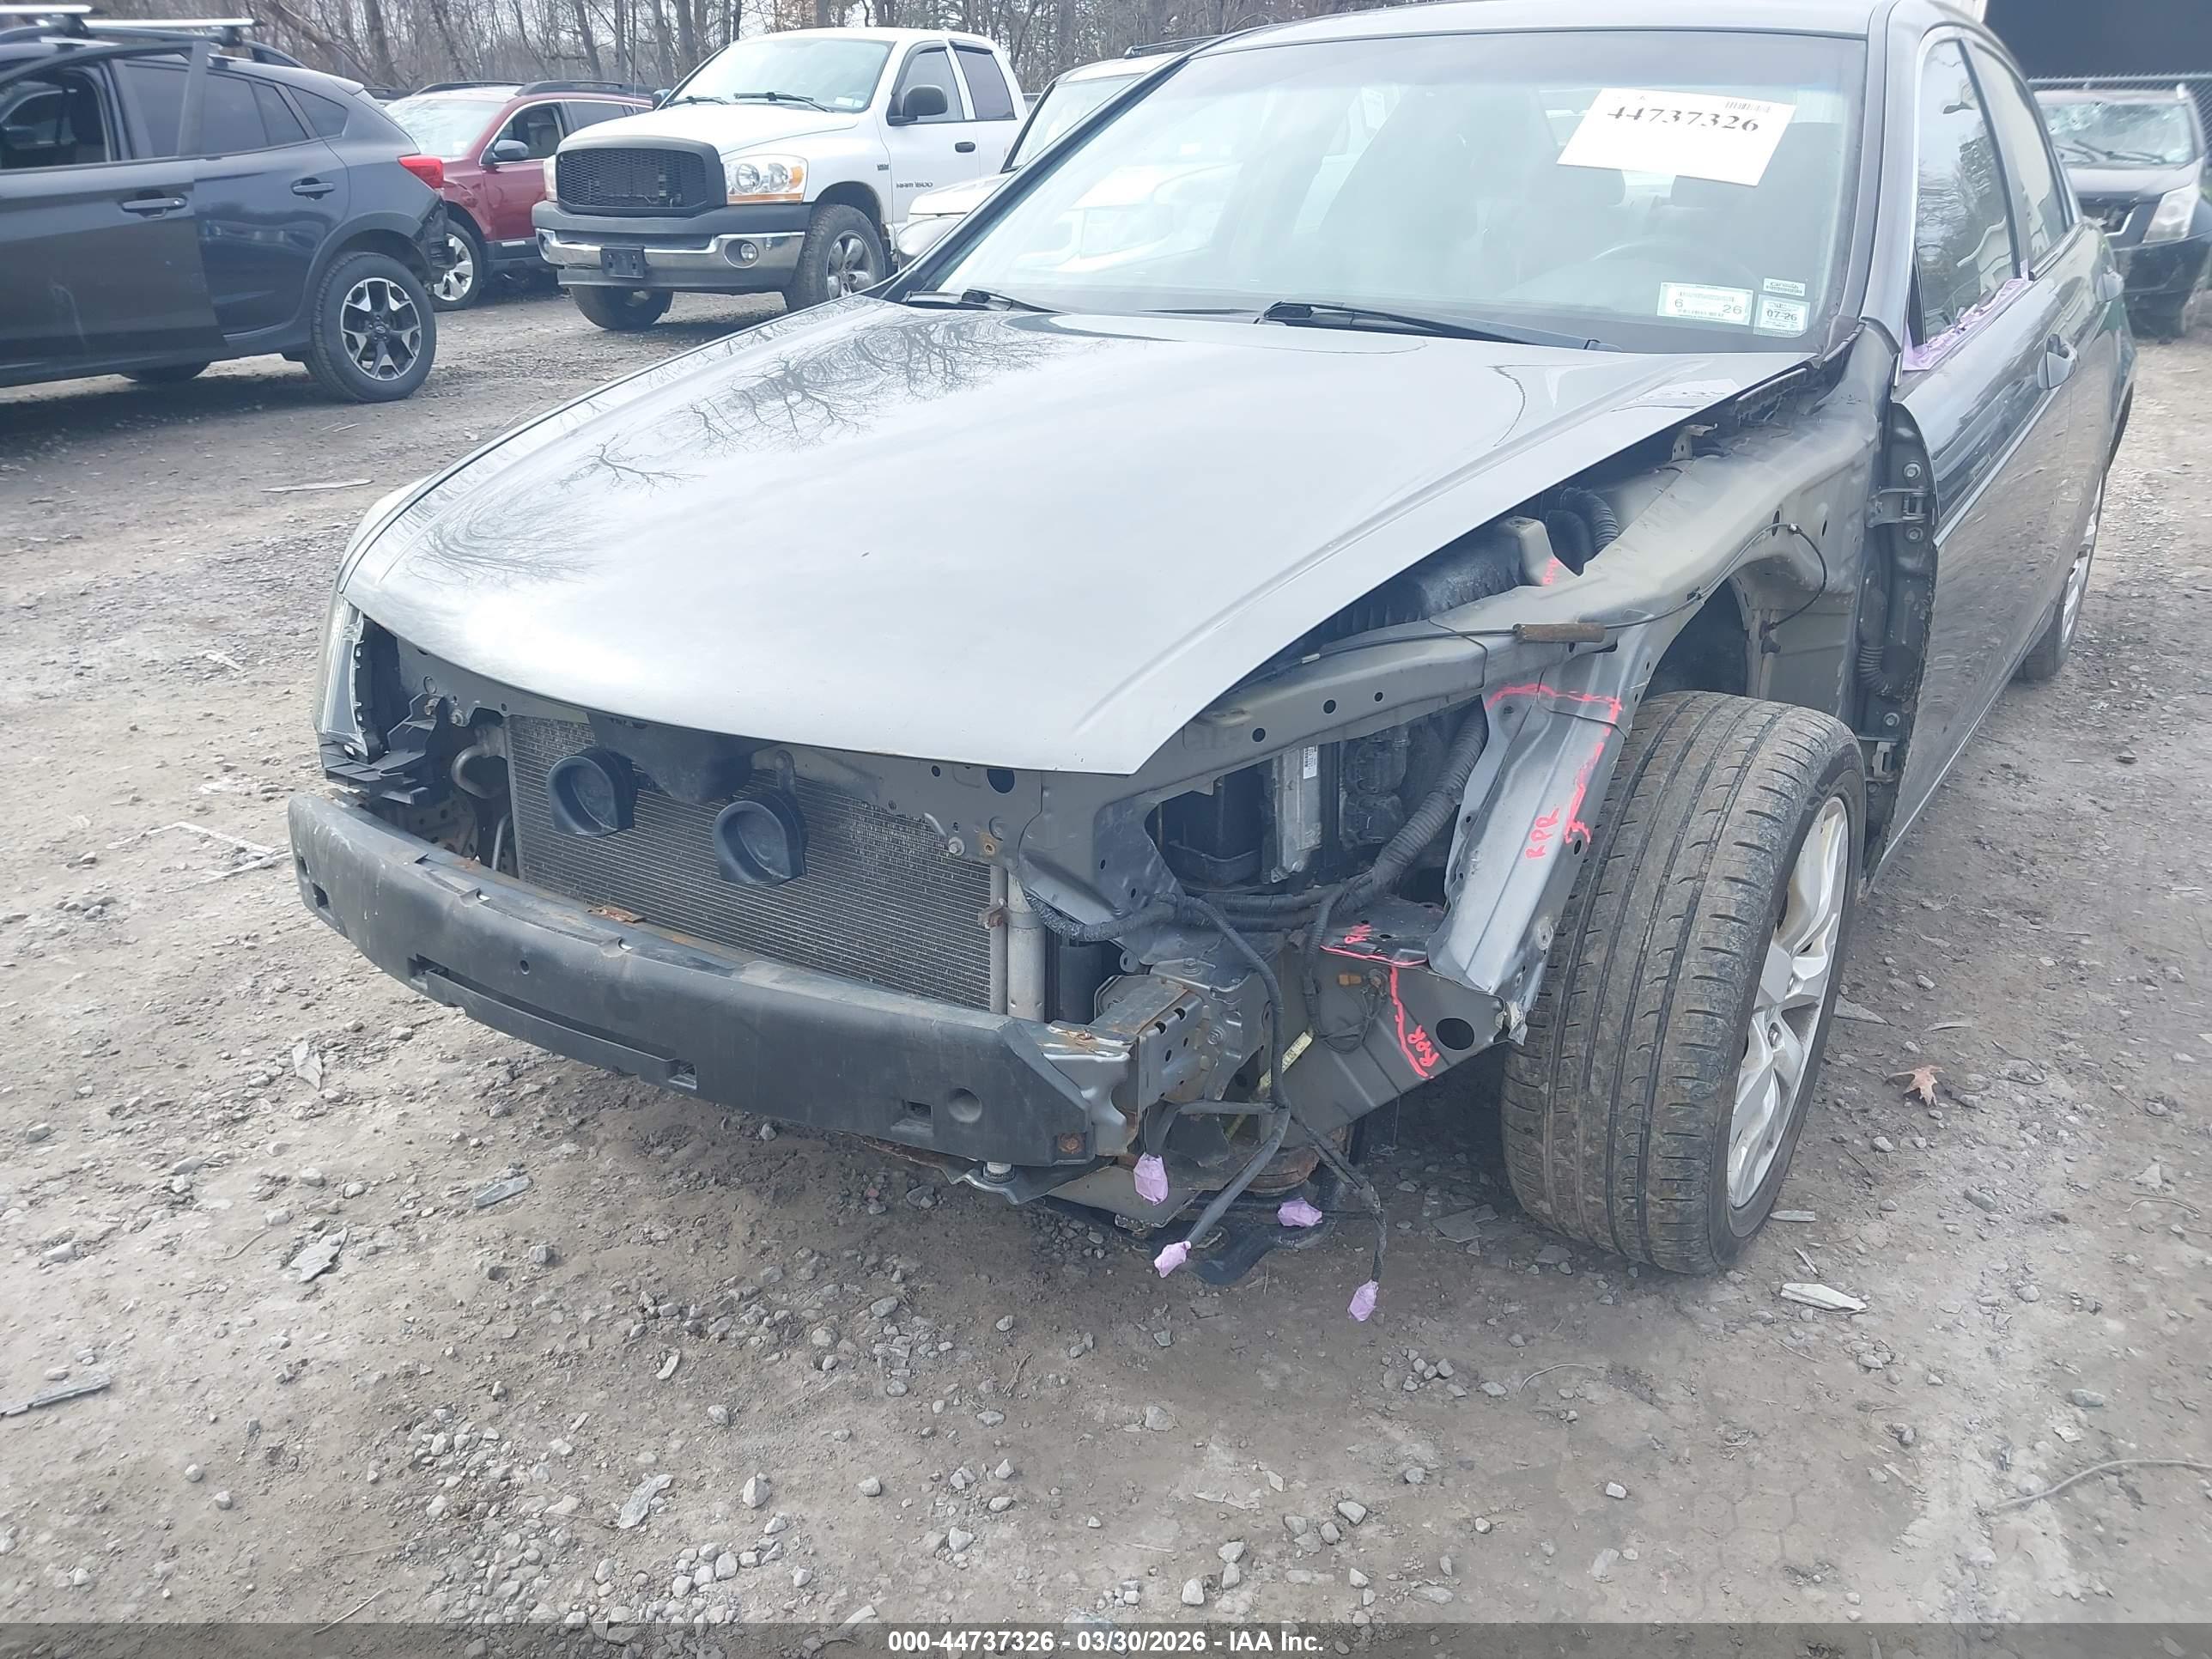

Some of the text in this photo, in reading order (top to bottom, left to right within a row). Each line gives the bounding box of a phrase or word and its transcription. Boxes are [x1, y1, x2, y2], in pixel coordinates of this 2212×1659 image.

[1607, 106, 1759, 131] 44737326
[1674, 298, 1683, 308] 6
[1723, 304, 1742, 315] 26
[1525, 807, 1559, 859] RPR
[1407, 1024, 1440, 1066] RPR
